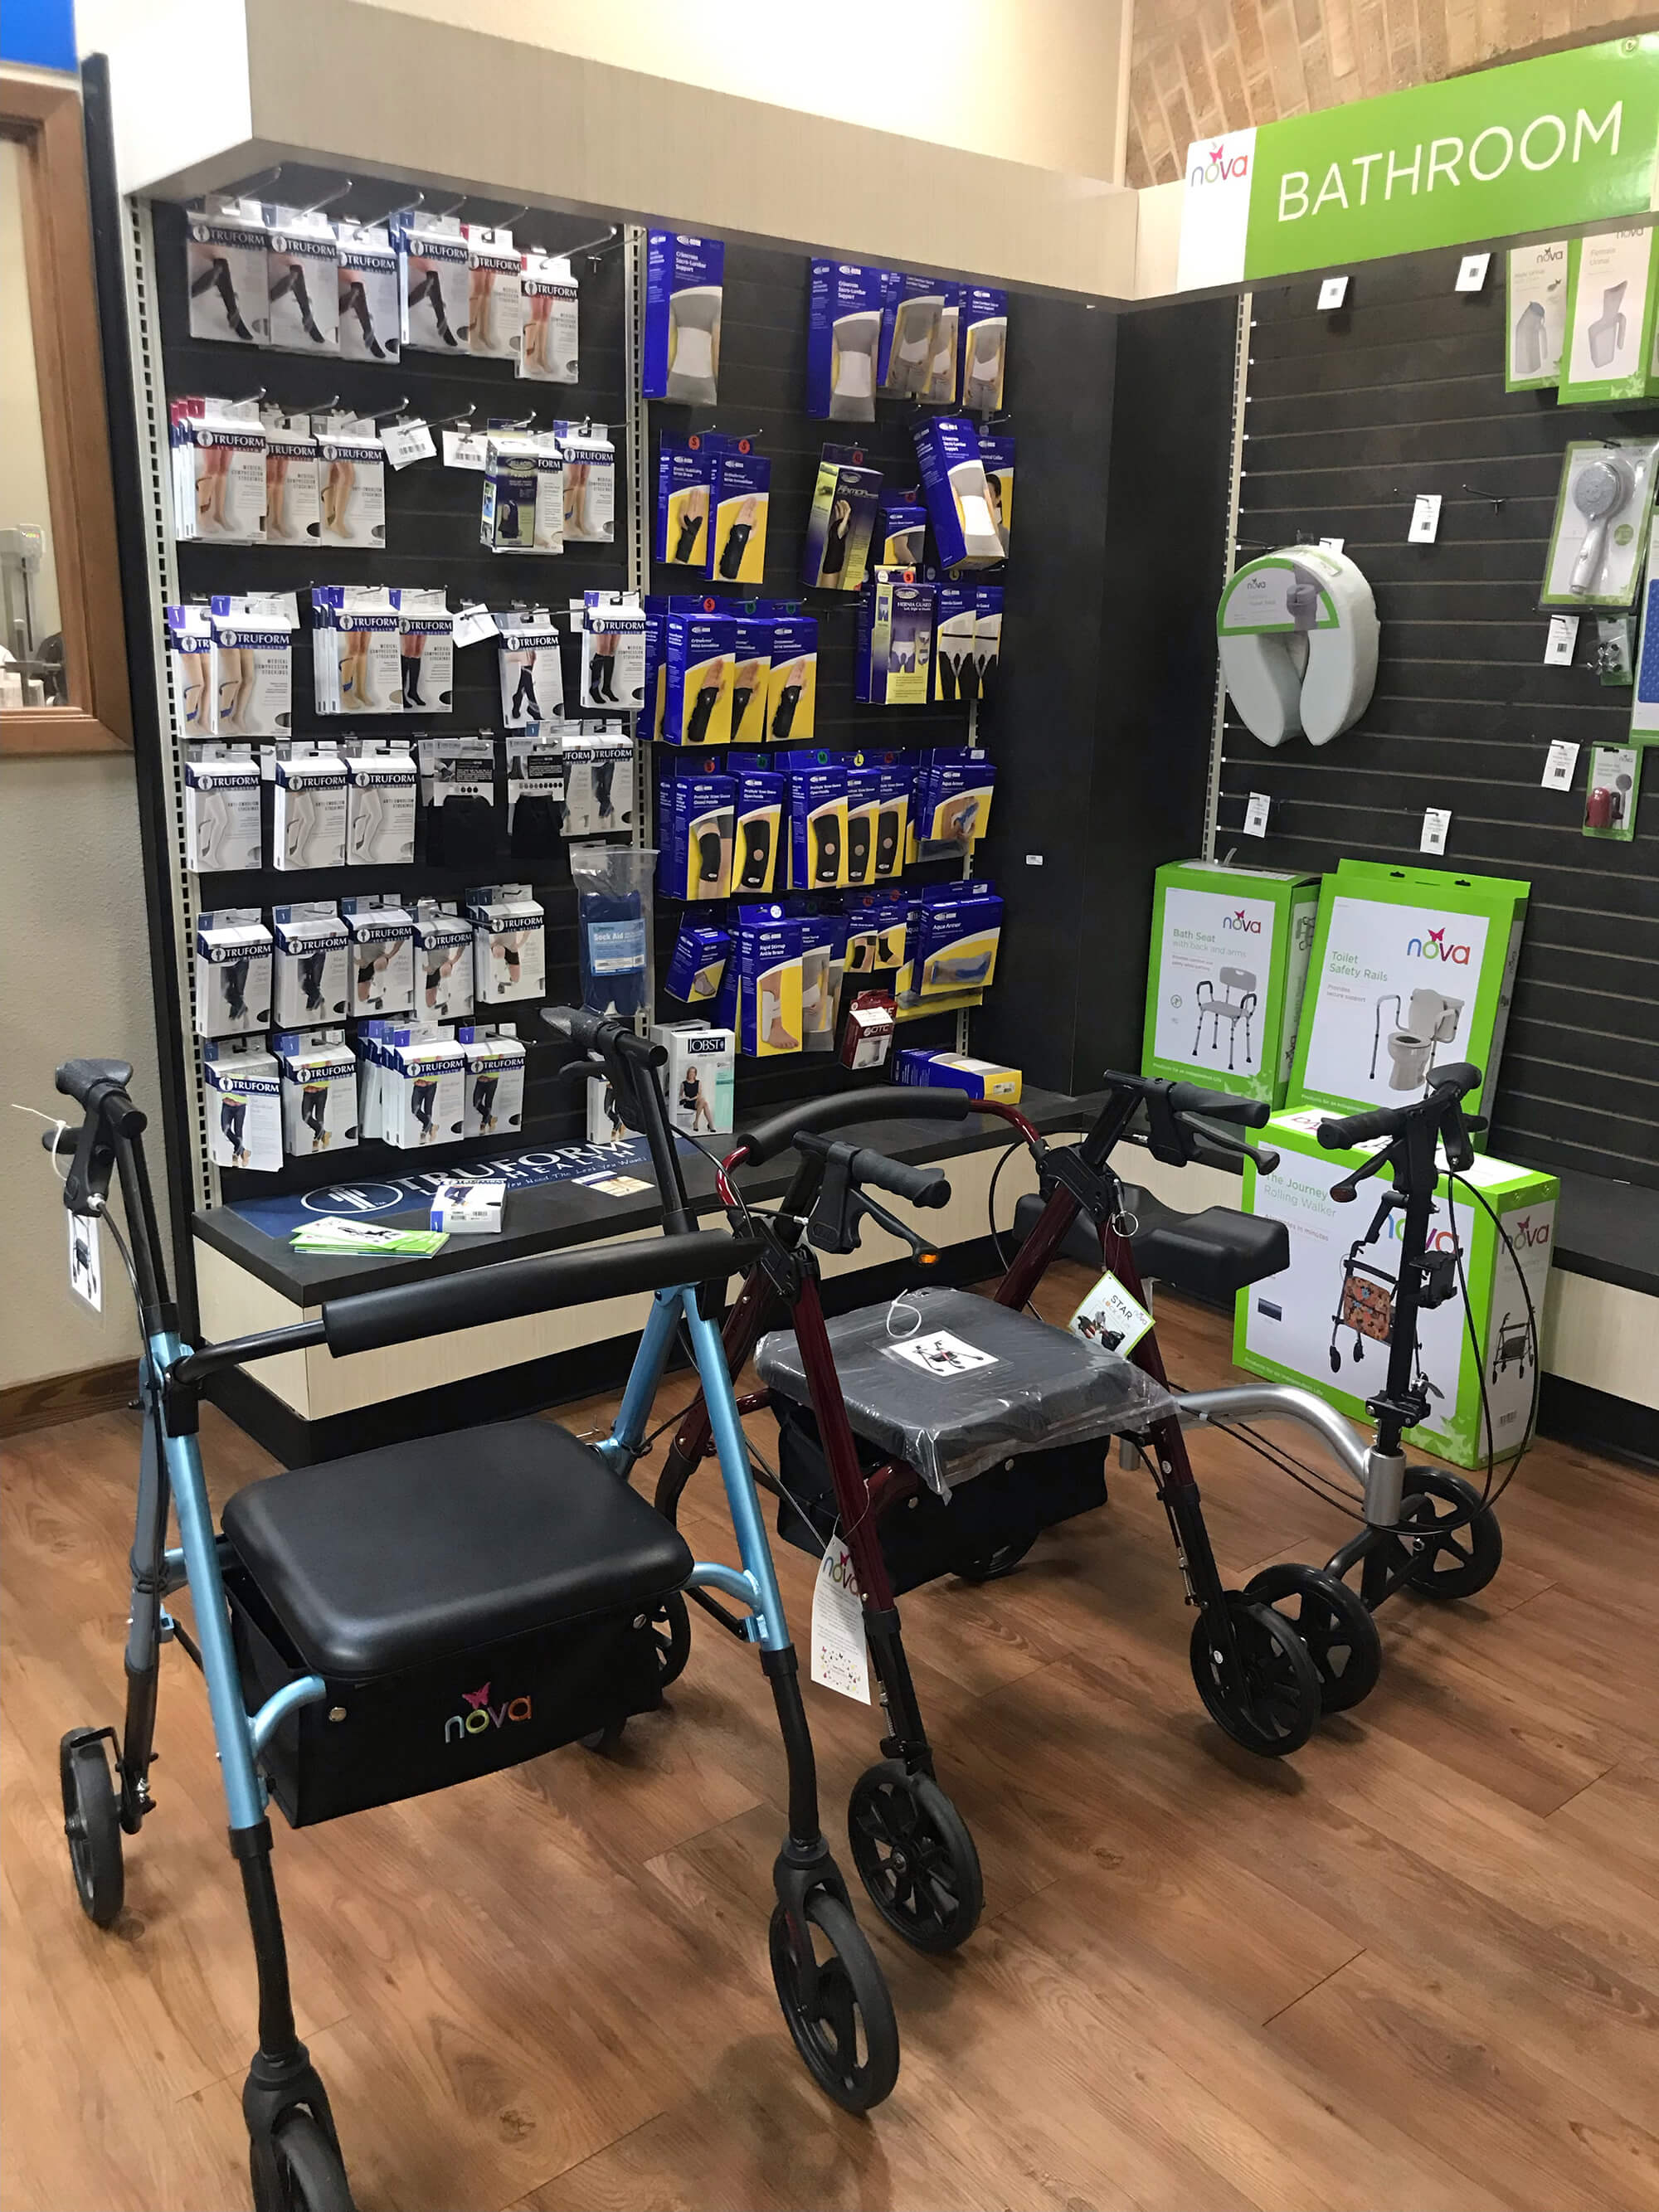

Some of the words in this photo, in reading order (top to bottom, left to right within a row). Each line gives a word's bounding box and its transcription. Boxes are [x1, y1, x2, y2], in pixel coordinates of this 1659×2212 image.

[1277, 100, 1623, 222] BATHROOM
[1190, 154, 1248, 187] nova
[288, 241, 335, 256] TRUFORM
[424, 243, 467, 259] TRUFORM
[347, 254, 395, 270] TRUFORM
[1536, 250, 1564, 264] nova
[479, 257, 520, 271] TRUFORM
[538, 284, 577, 298] TRUFORM
[212, 434, 265, 447] TRUFORM
[270, 445, 315, 456] TRUFORM
[337, 449, 382, 459] TRUFORM
[576, 451, 614, 462] TRUFORM
[353, 617, 397, 627] TRUFORM
[410, 621, 452, 630] TRUFORM
[605, 622, 645, 630] TRUFORM
[236, 634, 289, 644] TRUFORM
[520, 636, 558, 647] TRUFORM
[563, 751, 591, 760] UFORM
[596, 749, 632, 758] TRUFORM
[212, 776, 259, 786] TRUFORM
[302, 776, 346, 786] TRUFORM
[370, 774, 415, 783] TRUFORM
[504, 916, 543, 927] TRUFORM
[1223, 916, 1261, 934] nova
[371, 927, 412, 938] TRUFORM
[1173, 929, 1193, 940] Bath
[1196, 932, 1215, 942] Seat
[302, 938, 347, 950] TRUFORM
[436, 934, 472, 945] TRUFORM
[225, 945, 271, 958] TRUFORM
[1332, 950, 1359, 964] Toilet
[1407, 938, 1471, 965] nova
[1329, 963, 1360, 979] Safety
[1364, 969, 1388, 982] Rails
[689, 1038, 720, 1053] JOBST
[420, 1060, 463, 1072] TRUFORM
[484, 1057, 524, 1068] TRUFORM
[309, 1064, 355, 1077] TRUFORM
[233, 1080, 280, 1092] TRUFORM
[386, 1140, 636, 1190] TRUFORM
[505, 1150, 635, 1179] HEALTH
[1287, 1179, 1329, 1201] Journey
[1264, 1184, 1299, 1207] Rolling
[1301, 1198, 1337, 1218] Walker
[1501, 1224, 1550, 1255] nova
[1110, 1295, 1133, 1320] STAR
[445, 1695, 532, 1743] nova
